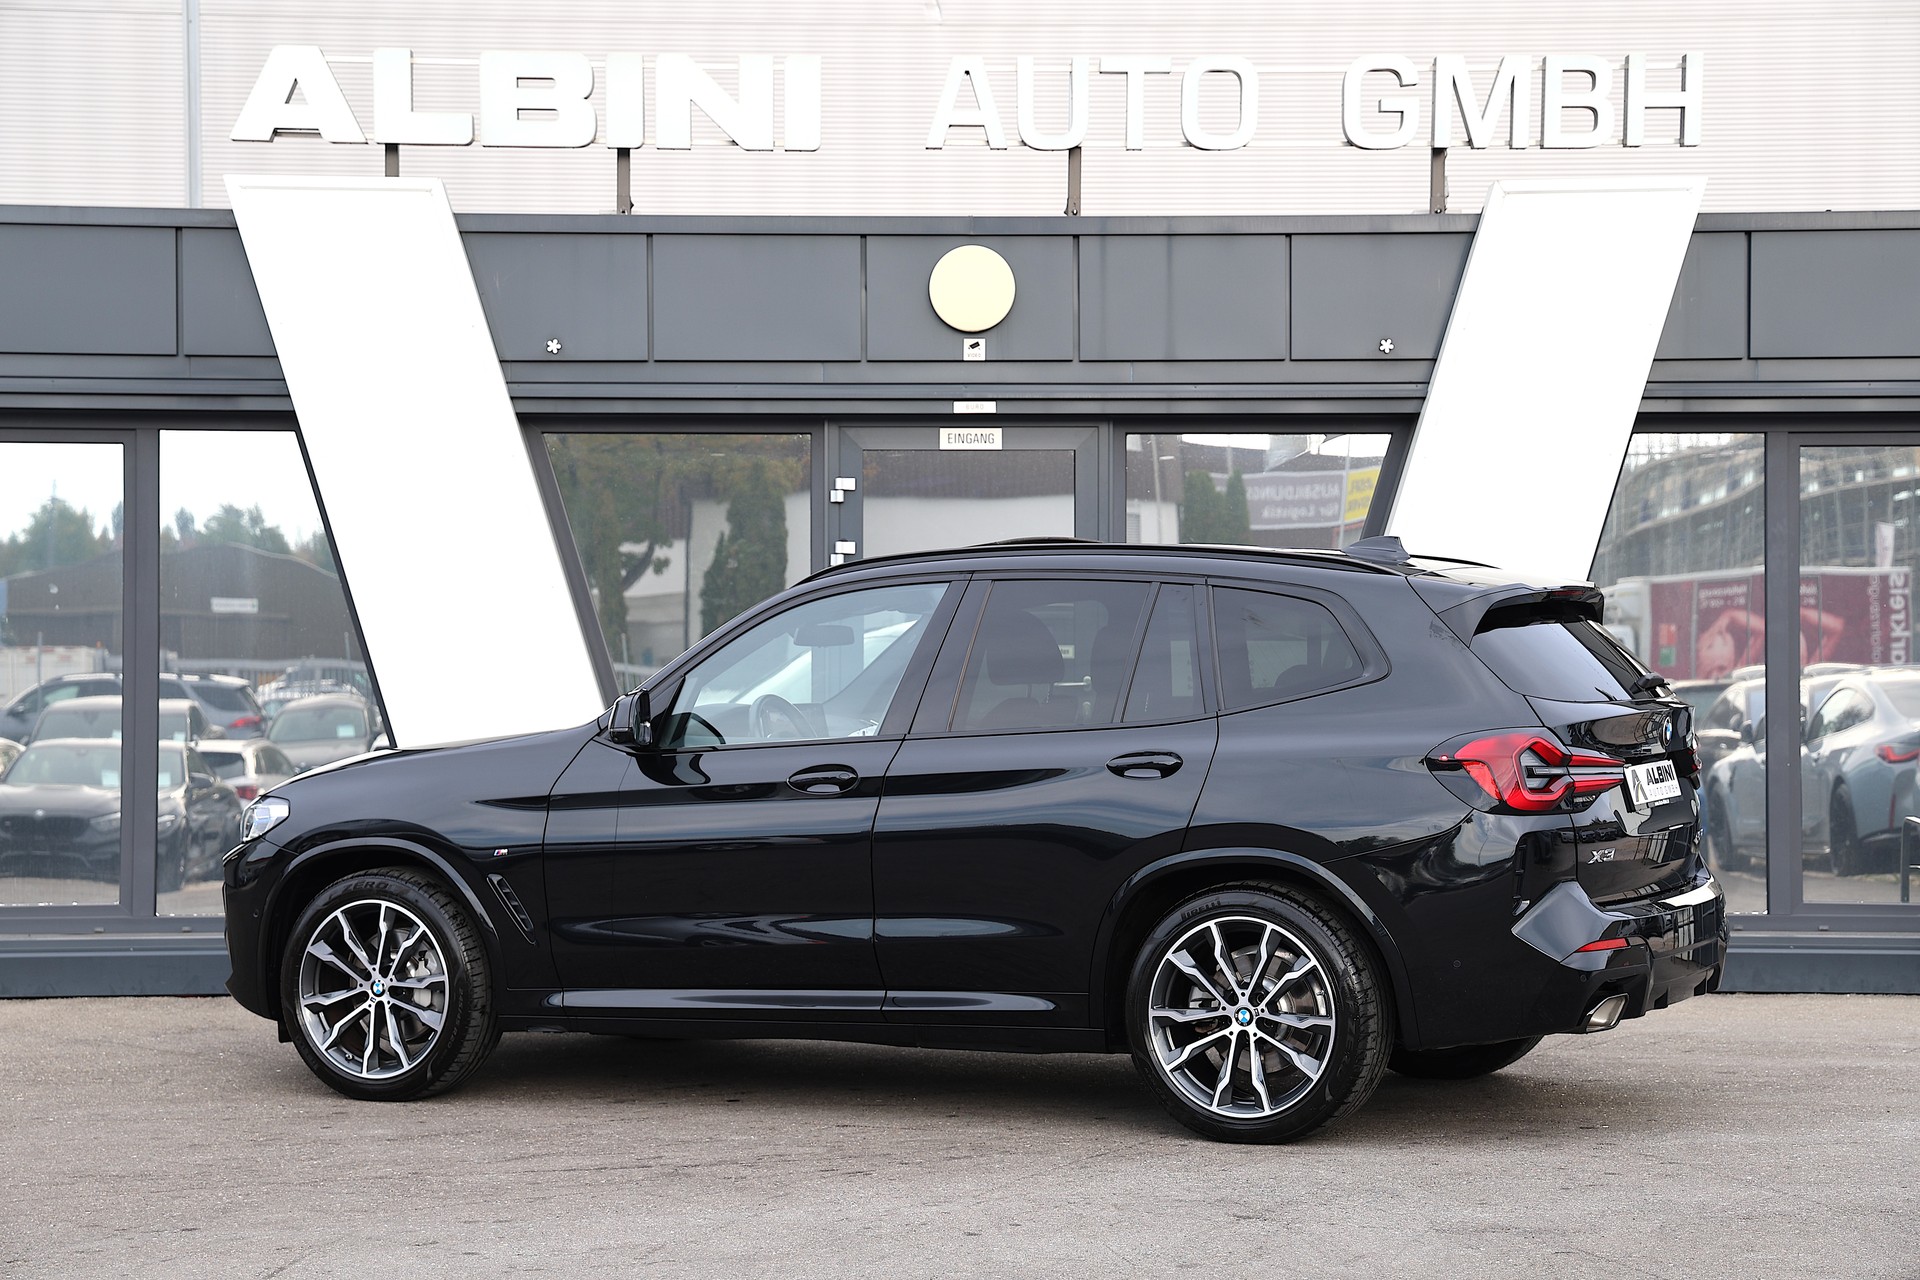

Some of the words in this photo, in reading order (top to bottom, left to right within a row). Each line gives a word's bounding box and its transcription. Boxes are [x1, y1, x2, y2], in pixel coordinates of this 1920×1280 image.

[229, 45, 822, 152] ALBINI
[925, 53, 1258, 152] AUTO
[1342, 51, 1704, 150] GMBH
[947, 433, 995, 444] EINGANG
[1646, 764, 1676, 786] ALBINI
[1588, 848, 1616, 865] X3
[342, 880, 390, 895] ZERO
